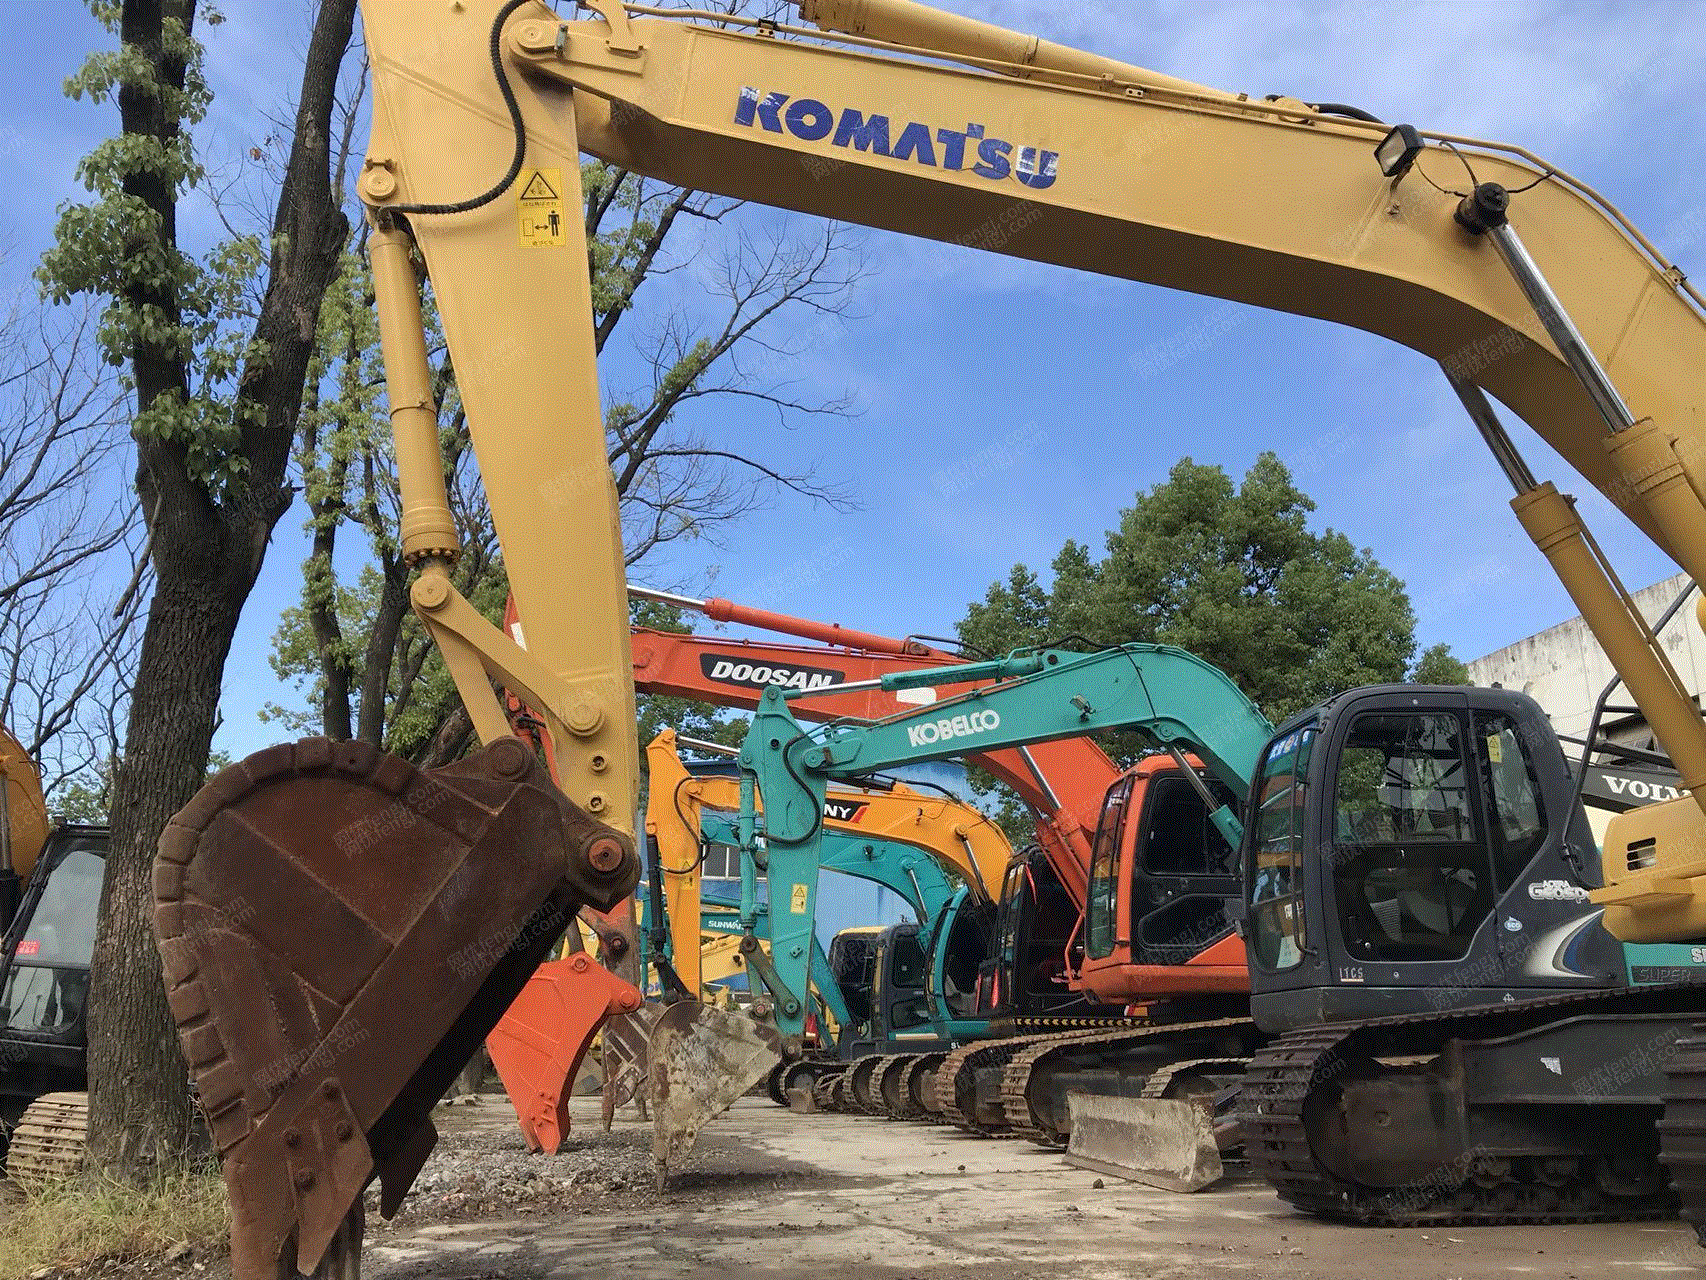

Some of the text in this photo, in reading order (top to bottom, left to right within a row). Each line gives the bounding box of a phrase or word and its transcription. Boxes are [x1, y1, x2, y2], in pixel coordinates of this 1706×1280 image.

[733, 86, 1059, 190] KOMATSU
[710, 660, 832, 688] DOOSAN
[907, 708, 1001, 748] KOBELCO
[1638, 967, 1692, 982] SUPER
